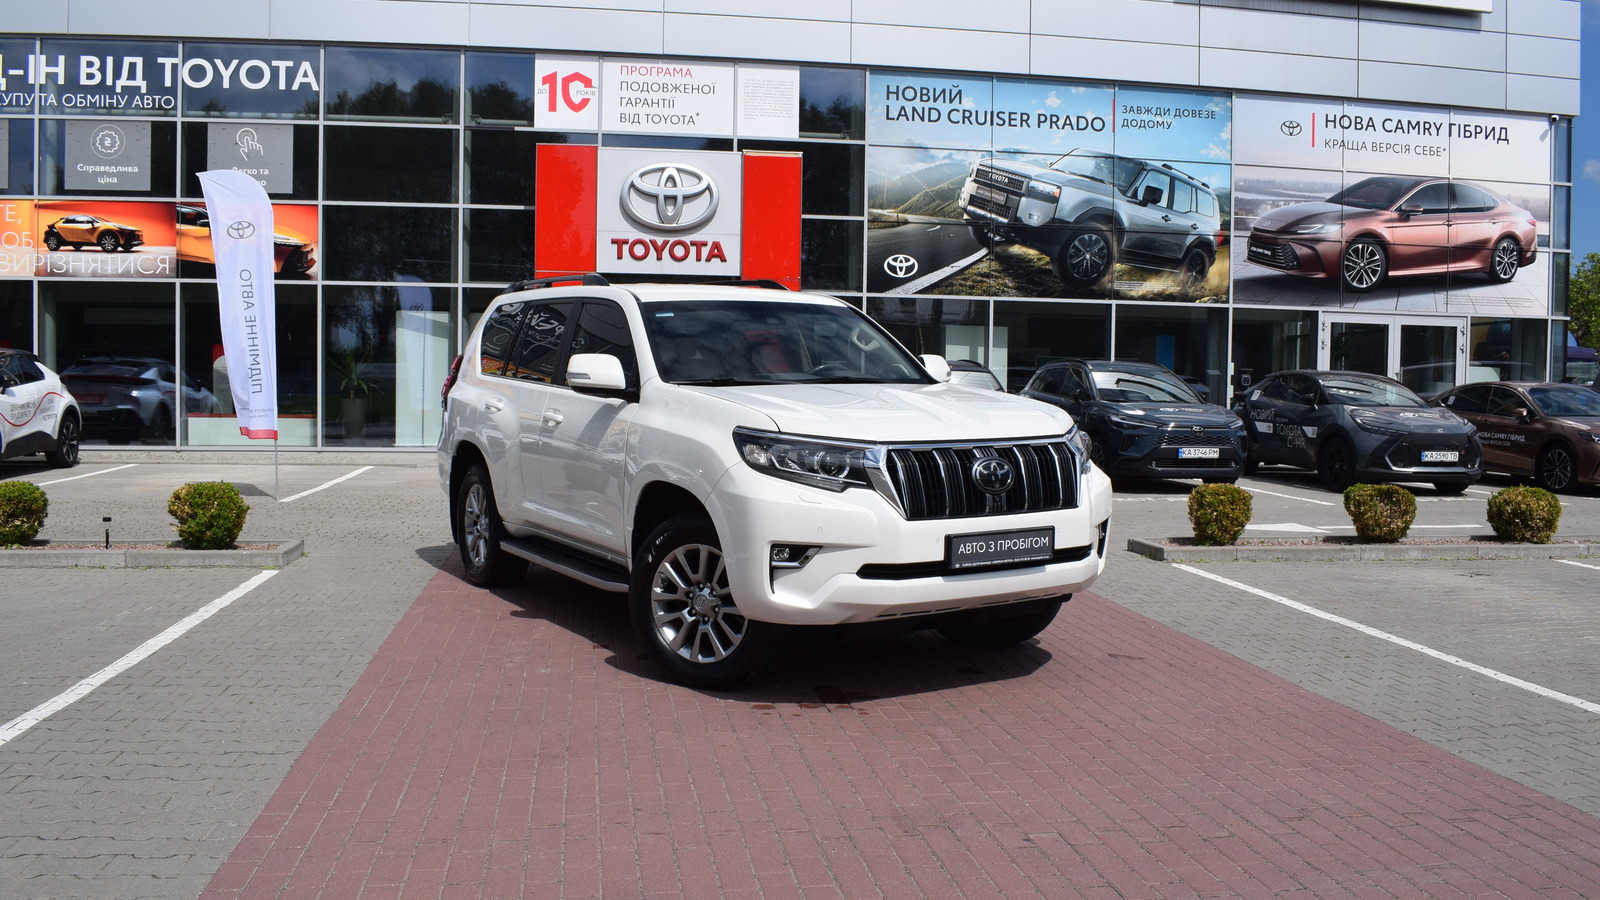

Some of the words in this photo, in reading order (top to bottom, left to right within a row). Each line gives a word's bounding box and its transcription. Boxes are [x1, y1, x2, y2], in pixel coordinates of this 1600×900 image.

[79, 55, 147, 93] ВІД
[157, 57, 320, 91] TOYOTA
[620, 65, 693, 78] ПРОГРАМА
[575, 89, 597, 97] РОКІВ
[620, 81, 716, 95] ПОДОВЖЕНОЇ
[886, 84, 963, 105] НОВИЙ
[39, 93, 58, 107] ТА
[62, 94, 128, 108] ОБМІНУ
[132, 95, 175, 109] АВТО
[619, 96, 675, 109] ГАРАНТІЇ
[619, 112, 641, 125] ВІД
[885, 105, 942, 123] LAND
[947, 108, 1032, 129] CRUISER
[1037, 114, 1106, 133] PRADO
[1121, 104, 1171, 118] ЗАВЖДИ
[1173, 107, 1217, 120] ДОВЕЗЕ
[1121, 118, 1173, 131] ДОДОМУ
[1325, 113, 1377, 132] НОВА
[1381, 117, 1443, 137] CAMRY
[1449, 123, 1510, 145] ГІБРИД
[1324, 138, 1367, 153] КРАЩА
[1371, 142, 1411, 155] ВЕРСІЯ
[77, 163, 139, 174] Справедлива
[97, 174, 118, 184] ціна
[610, 238, 727, 262] TOYOTA
[1275, 423, 1303, 437] TOYOTA
[1287, 436, 1306, 449] C-HR
[1424, 452, 1434, 460] KA
[958, 541, 986, 555] АВТО
[997, 536, 1049, 551] ПРОБІГОМ
